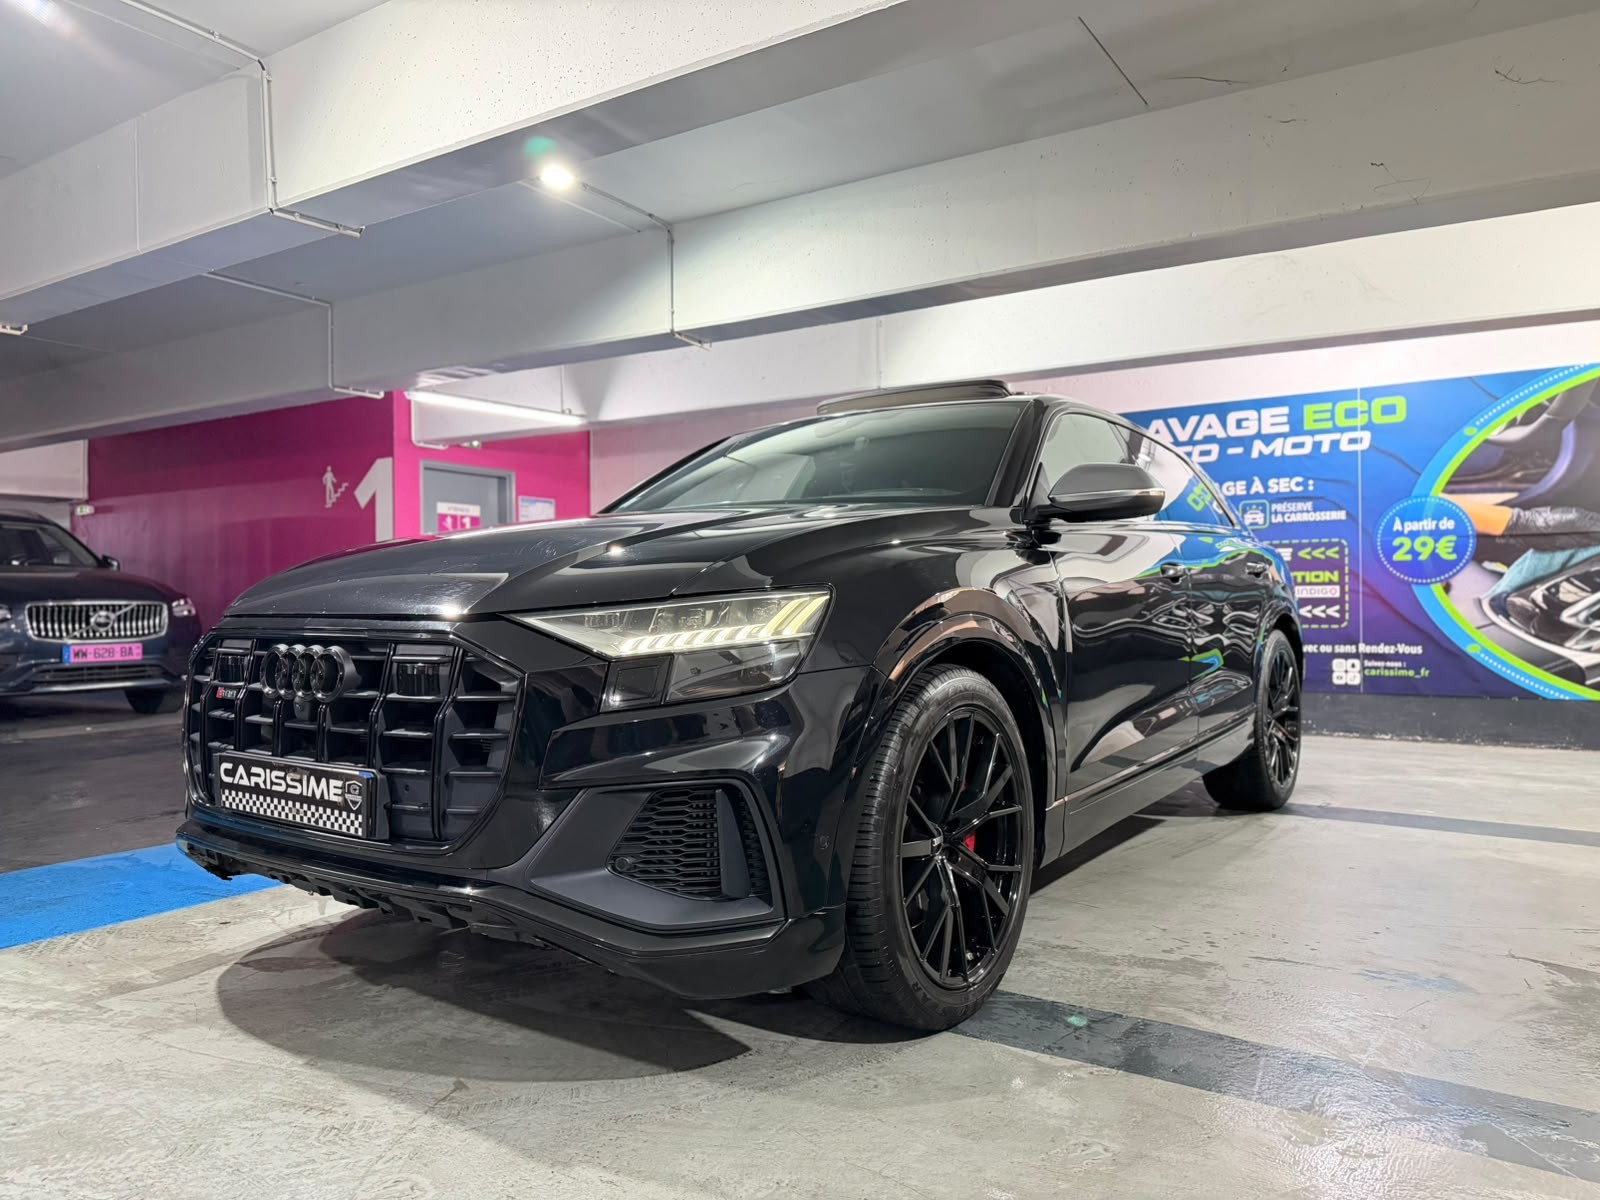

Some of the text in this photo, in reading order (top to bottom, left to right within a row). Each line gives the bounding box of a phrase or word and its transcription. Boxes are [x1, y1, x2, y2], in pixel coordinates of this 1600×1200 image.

[1303, 395, 1408, 431] ECO
[1251, 431, 1372, 459] MOTO
[1249, 476, 1265, 495] À
[1267, 477, 1305, 494] SEC
[354, 457, 393, 543] 1
[1271, 501, 1313, 513] PRÉSERVE
[1271, 510, 1347, 524] LA CARROSSERIE
[1392, 516, 1456, 534] À partir de
[1392, 535, 1458, 562] 29€
[1319, 644, 1333, 653] ou
[1334, 643, 1357, 654] sans
[1358, 642, 1423, 655] Rendez-Vous
[219, 762, 344, 802] CARISSIME
